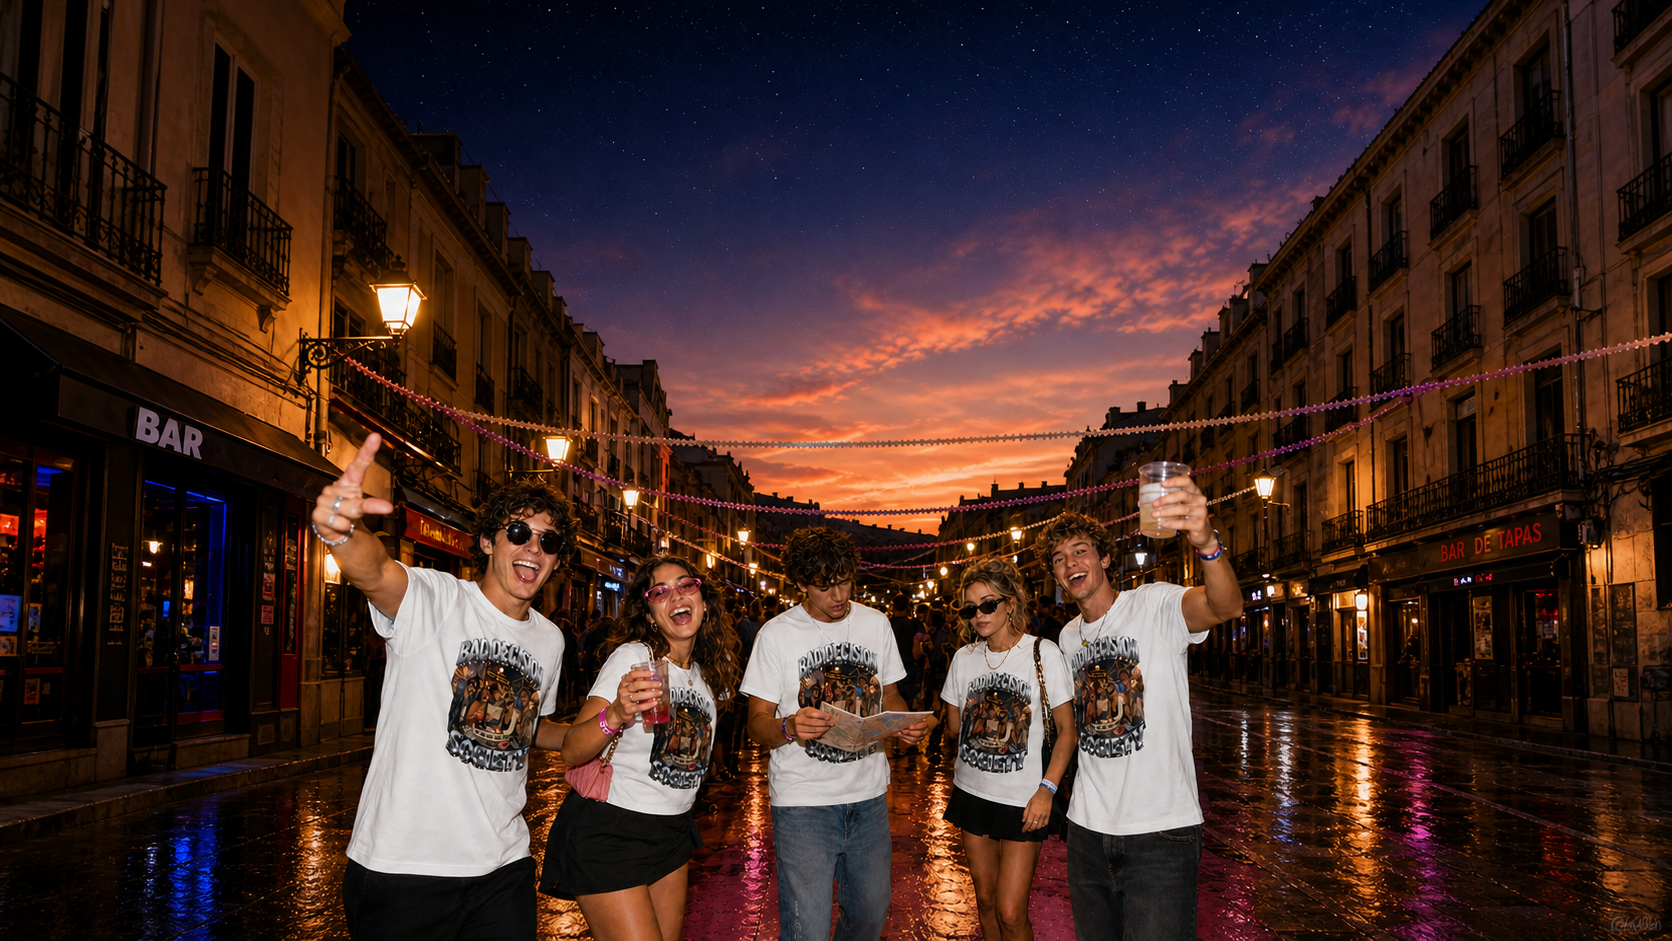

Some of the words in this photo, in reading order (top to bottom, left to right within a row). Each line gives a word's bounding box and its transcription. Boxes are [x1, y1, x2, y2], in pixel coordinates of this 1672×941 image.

[135, 405, 204, 460] BAR
[1440, 540, 1466, 562] BAR
[1474, 534, 1492, 555] DE
[1497, 522, 1542, 550] TAPAS
[456, 638, 490, 666] BAD
[798, 649, 823, 680] BAD
